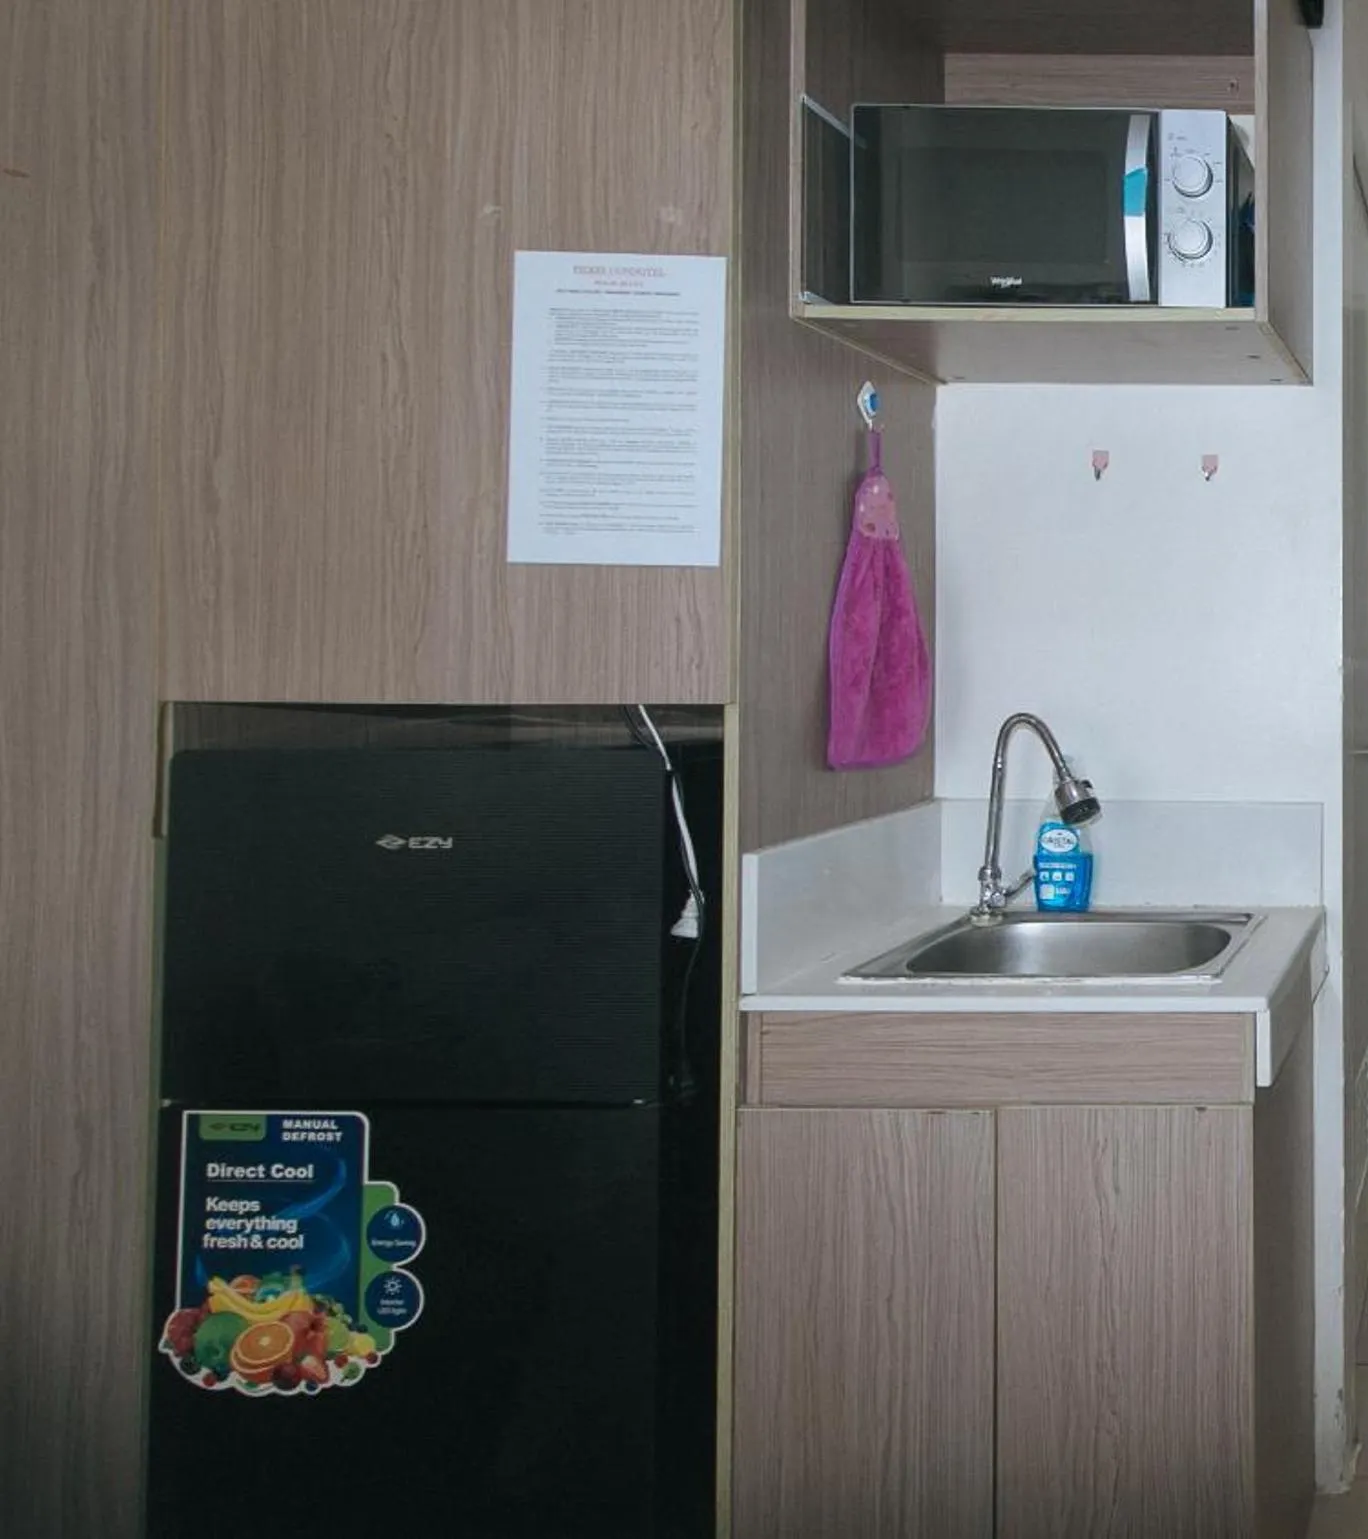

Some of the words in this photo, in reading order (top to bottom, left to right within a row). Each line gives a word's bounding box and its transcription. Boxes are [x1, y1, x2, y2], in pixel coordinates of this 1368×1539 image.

[282, 1119, 338, 1129] MANUAL
[282, 1131, 342, 1141] DEFROST
[206, 1162, 265, 1178] Direct
[270, 1163, 314, 1179] Cool
[206, 1197, 260, 1215] Keeps
[206, 1216, 297, 1234] everything
[203, 1233, 247, 1249] fresh
[249, 1234, 263, 1249] &
[266, 1234, 304, 1250] cool
